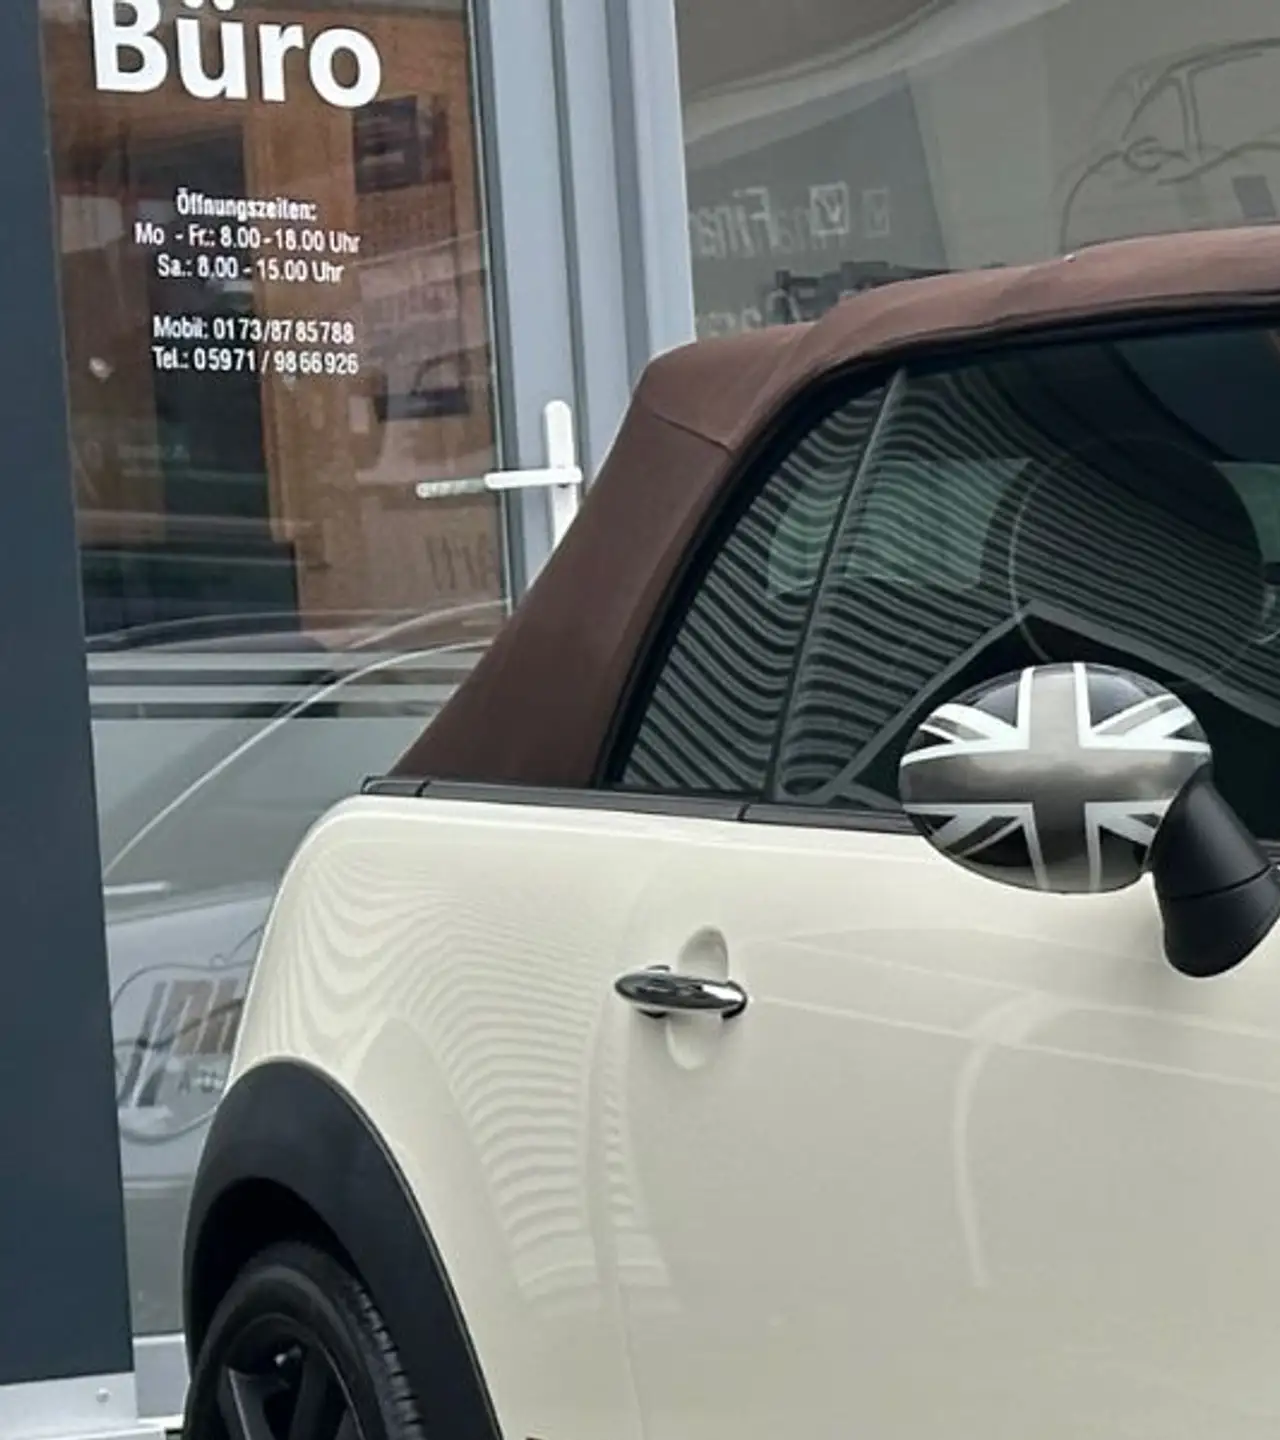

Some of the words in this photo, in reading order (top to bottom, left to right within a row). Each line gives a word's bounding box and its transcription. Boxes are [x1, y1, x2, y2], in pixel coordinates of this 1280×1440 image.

[90, 0, 382, 109] Büro
[176, 187, 318, 222] Öffnungszeiten:
[135, 222, 165, 245] Mo
[329, 231, 361, 253] Uhr
[157, 254, 192, 278] Sa.:
[312, 262, 345, 283] Uhr
[153, 315, 209, 341] Mobil:
[152, 346, 189, 371] Tel.:
